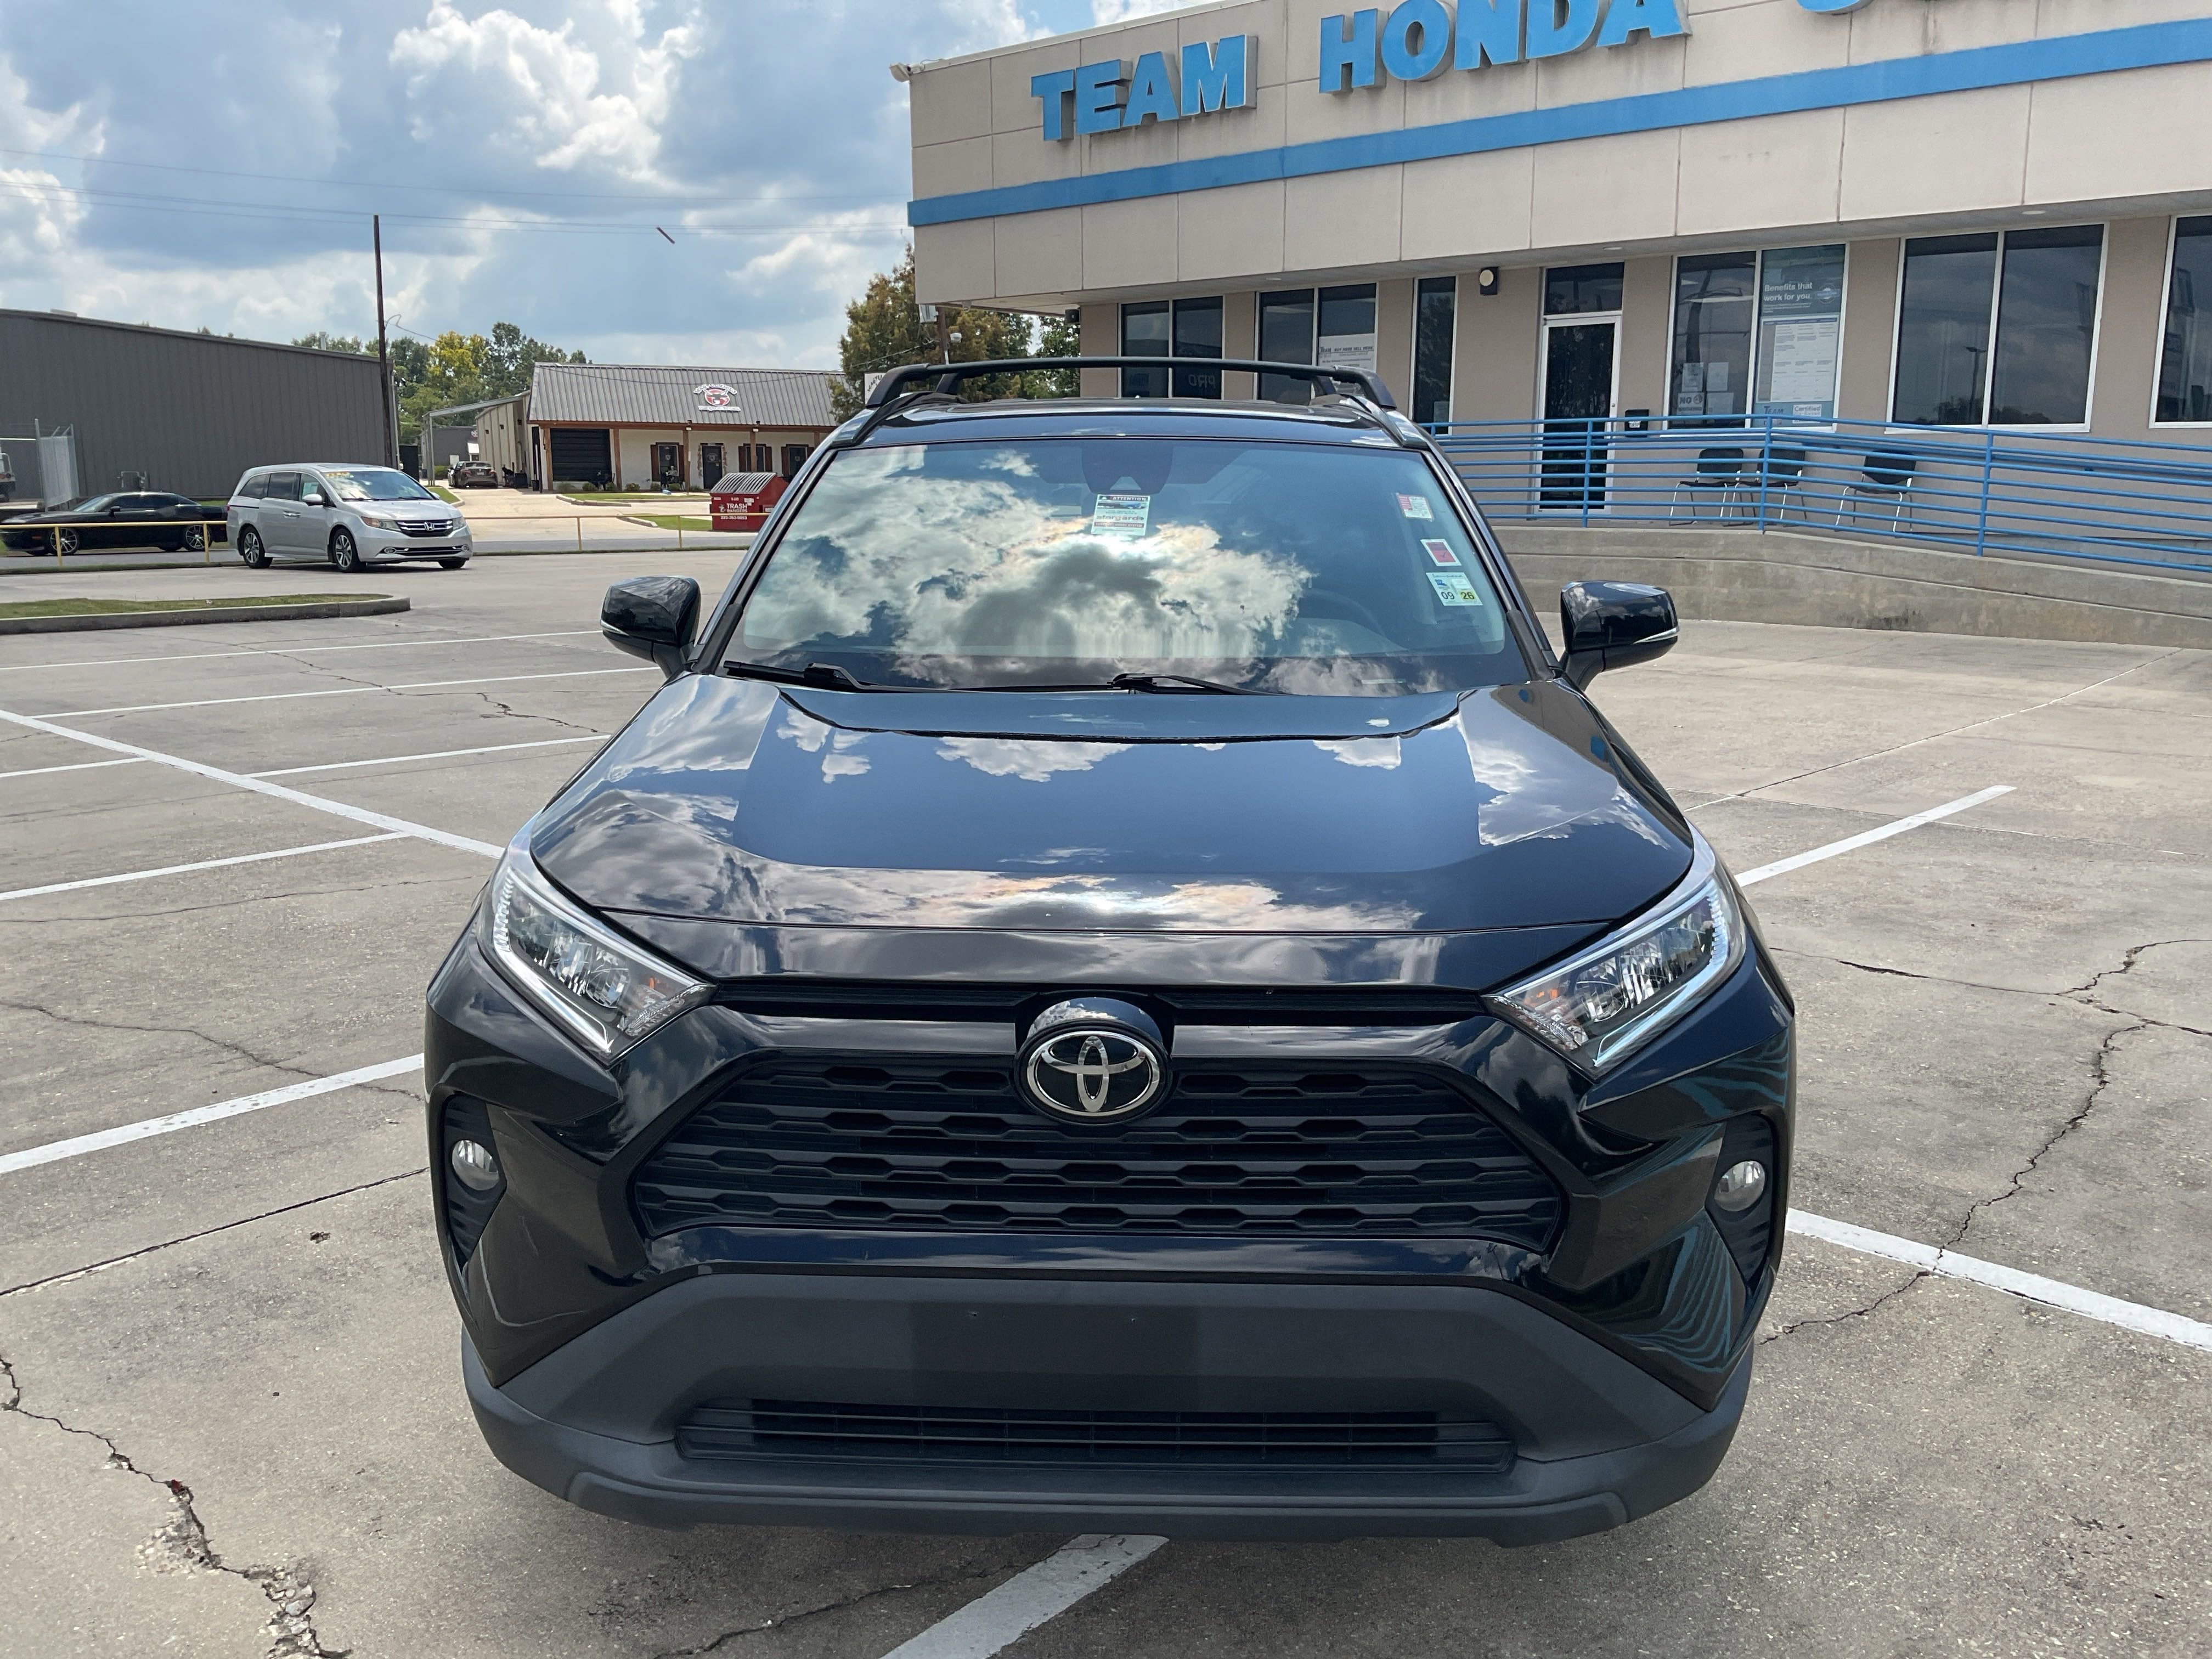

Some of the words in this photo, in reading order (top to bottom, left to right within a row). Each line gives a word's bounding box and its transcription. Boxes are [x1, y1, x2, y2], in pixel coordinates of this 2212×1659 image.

[1031, 34, 1255, 142] TEAM
[1319, 0, 1691, 93] HONDA
[1764, 284, 1796, 292] Benefits
[1763, 294, 1782, 302] work
[1764, 406, 1784, 414] TEAM
[1441, 591, 1455, 600] 09
[1460, 591, 1475, 600] 26
